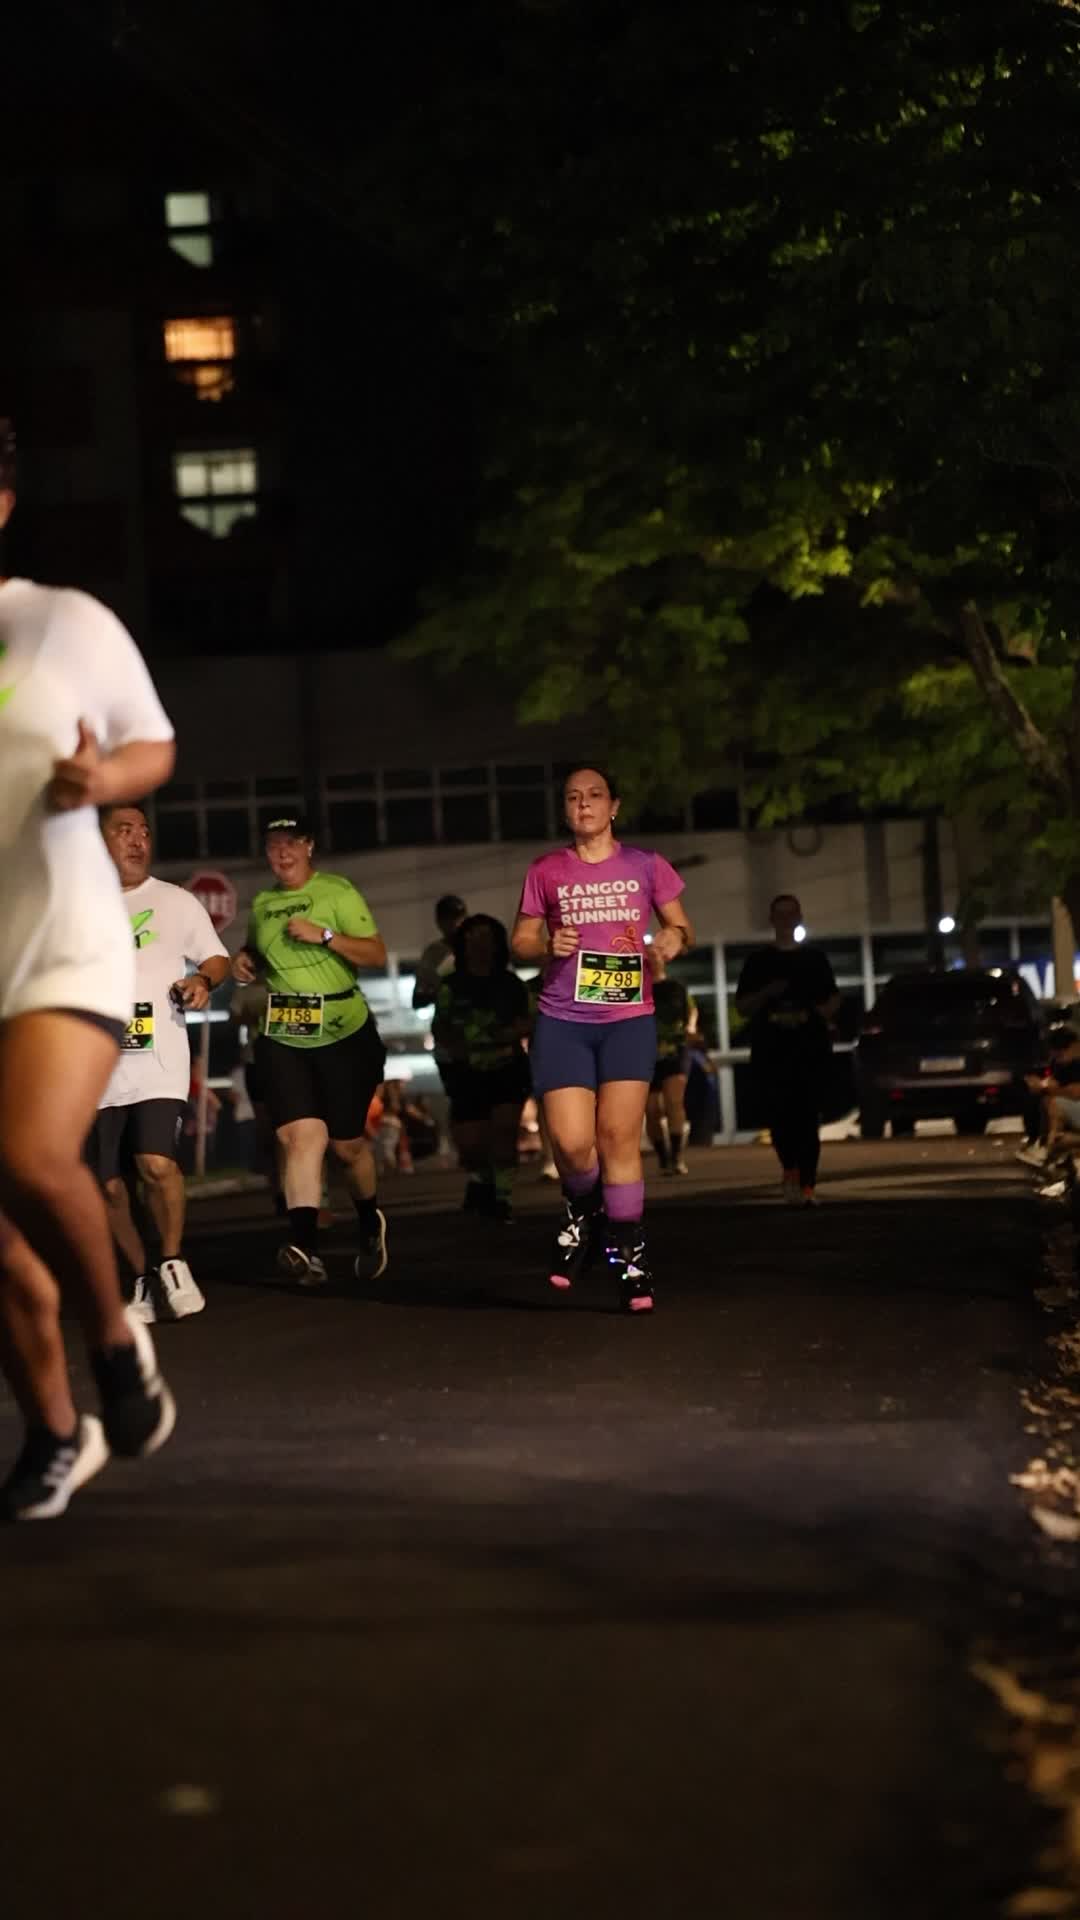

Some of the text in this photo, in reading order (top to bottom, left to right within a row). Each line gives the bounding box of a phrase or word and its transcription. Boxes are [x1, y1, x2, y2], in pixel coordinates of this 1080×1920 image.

[557, 880, 640, 899] KANGOO
[560, 895, 628, 912] STREET
[561, 909, 641, 926] RUNNING
[592, 971, 632, 987] 2798
[277, 1009, 311, 1022] 2158
